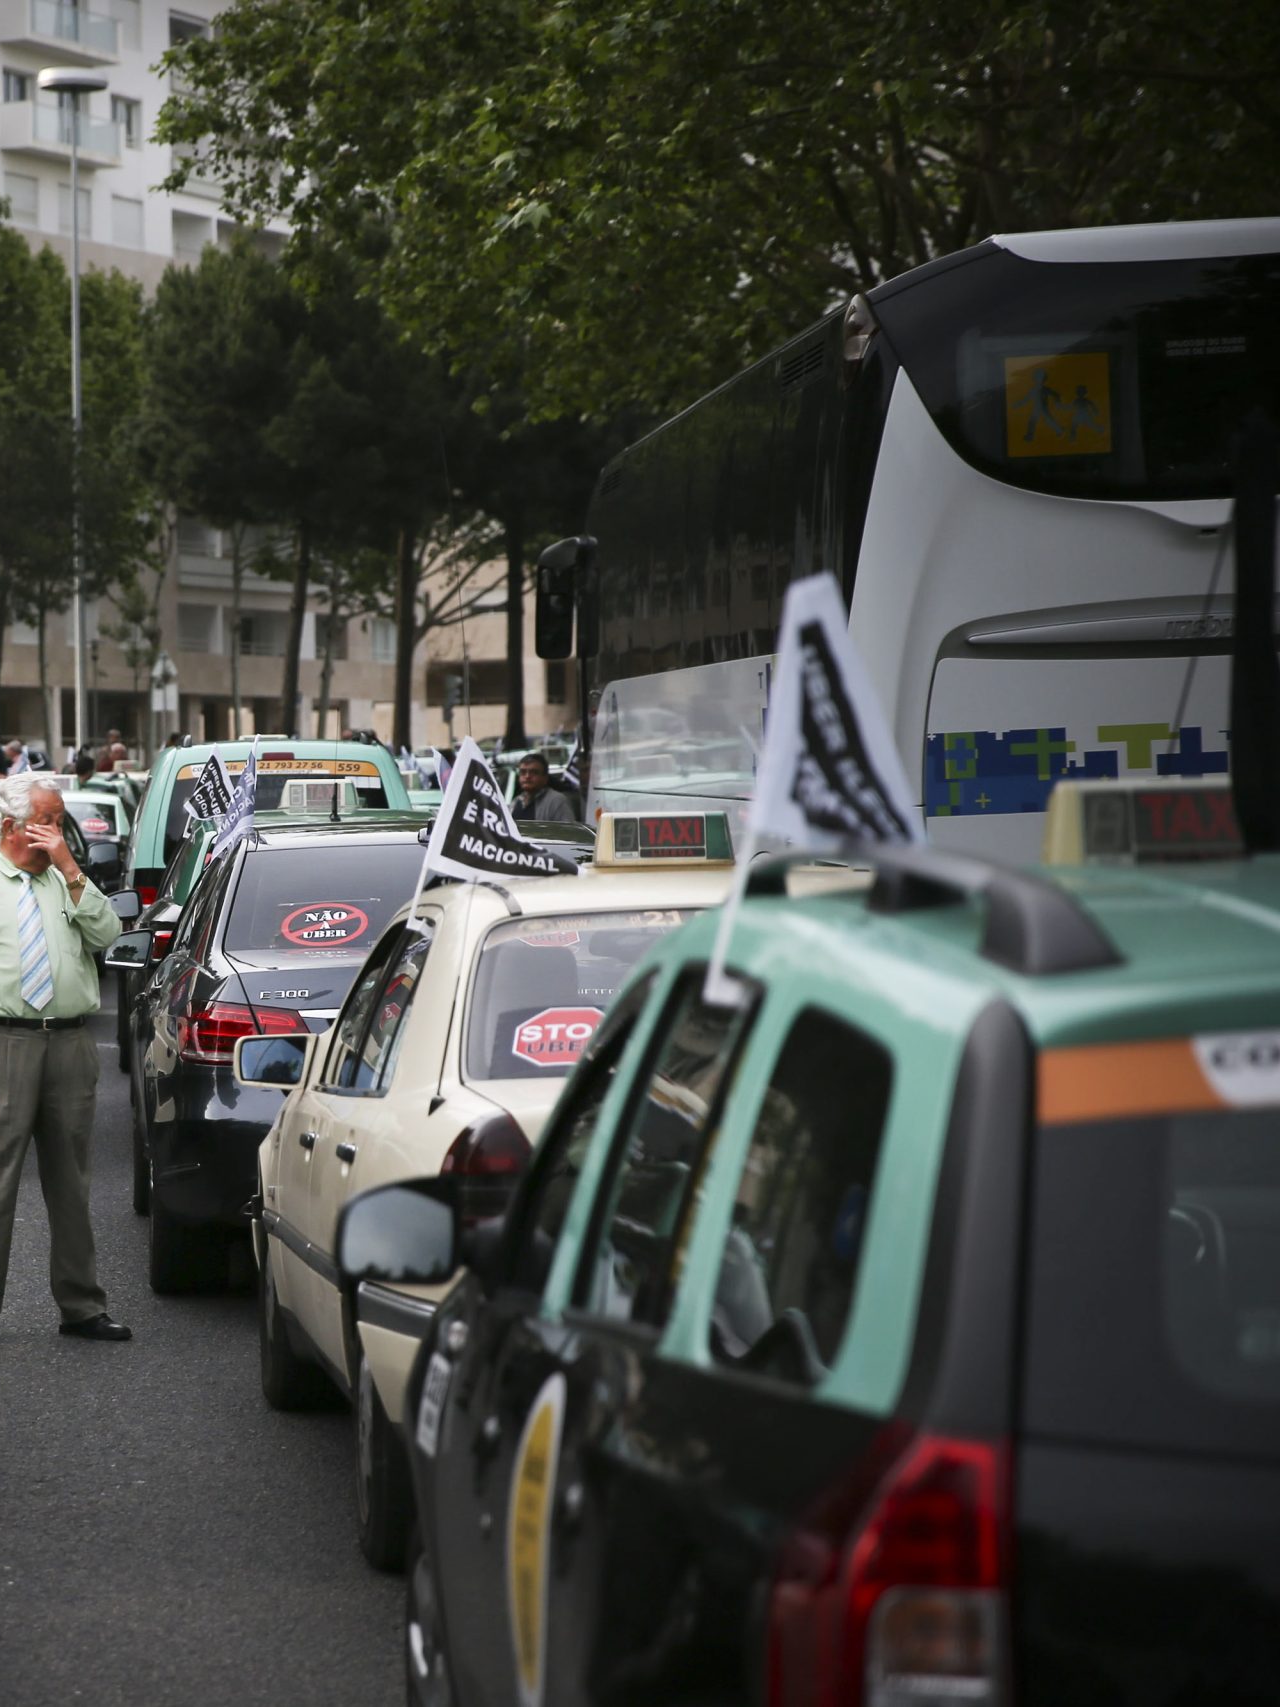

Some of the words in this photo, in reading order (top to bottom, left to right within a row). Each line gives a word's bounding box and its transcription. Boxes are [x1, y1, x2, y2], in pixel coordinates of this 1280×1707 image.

[259, 761, 271, 770] 21
[274, 761, 294, 770] 793
[296, 762, 308, 770] 27
[310, 762, 323, 770] 56
[336, 762, 362, 773] 559
[463, 799, 479, 823] É
[643, 818, 703, 846] TAXI
[460, 833, 560, 872] NACIONAL
[304, 910, 348, 922] NÃO
[319, 921, 331, 929] A
[302, 929, 347, 939] UBER
[260, 990, 272, 1000] E
[274, 989, 309, 1000] 300
[520, 1022, 594, 1043] STO
[526, 1039, 583, 1055] UBE
